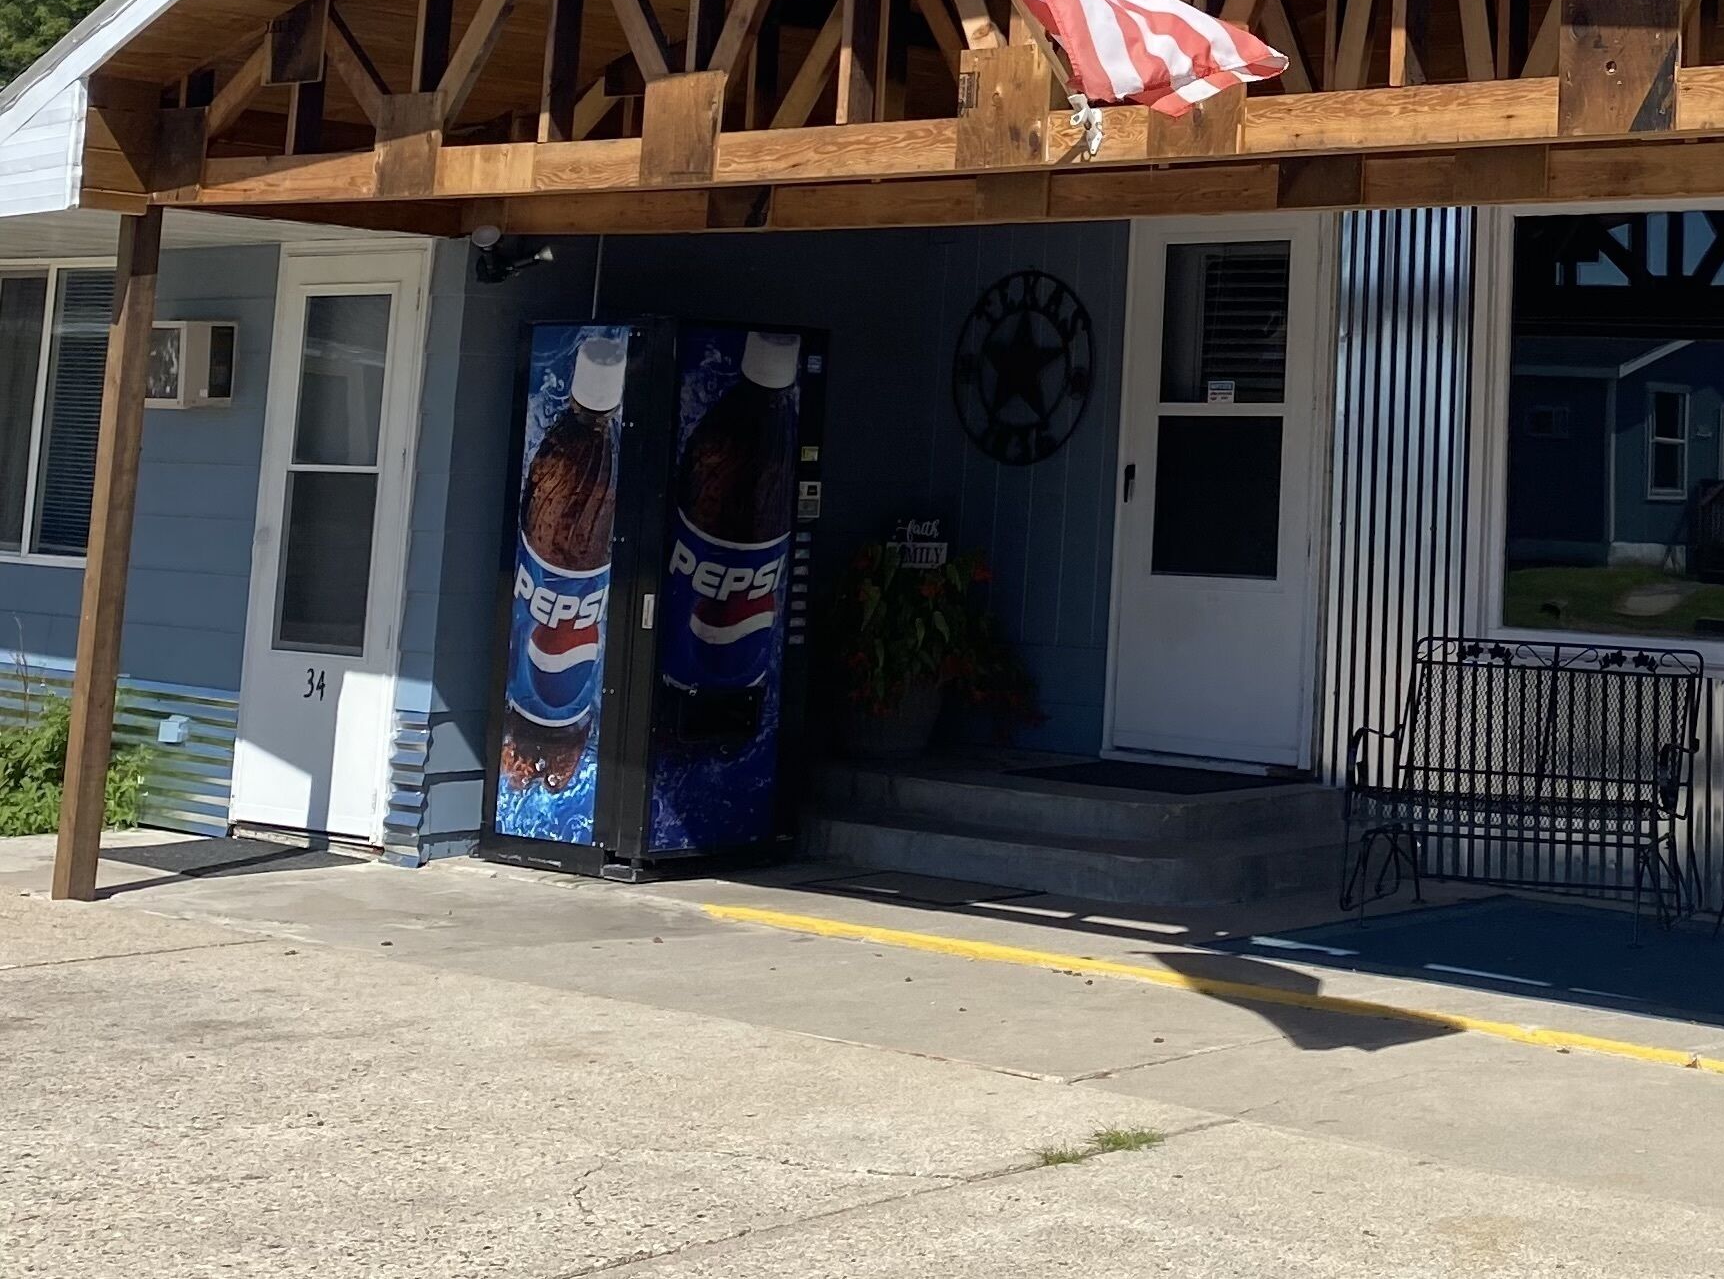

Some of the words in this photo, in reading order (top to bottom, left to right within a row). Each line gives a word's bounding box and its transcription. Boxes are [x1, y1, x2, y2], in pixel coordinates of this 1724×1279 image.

[973, 272, 1093, 337] TEXAS
[513, 562, 610, 630] PEPSI
[669, 538, 786, 601] PEPSI
[303, 668, 326, 702] 34
